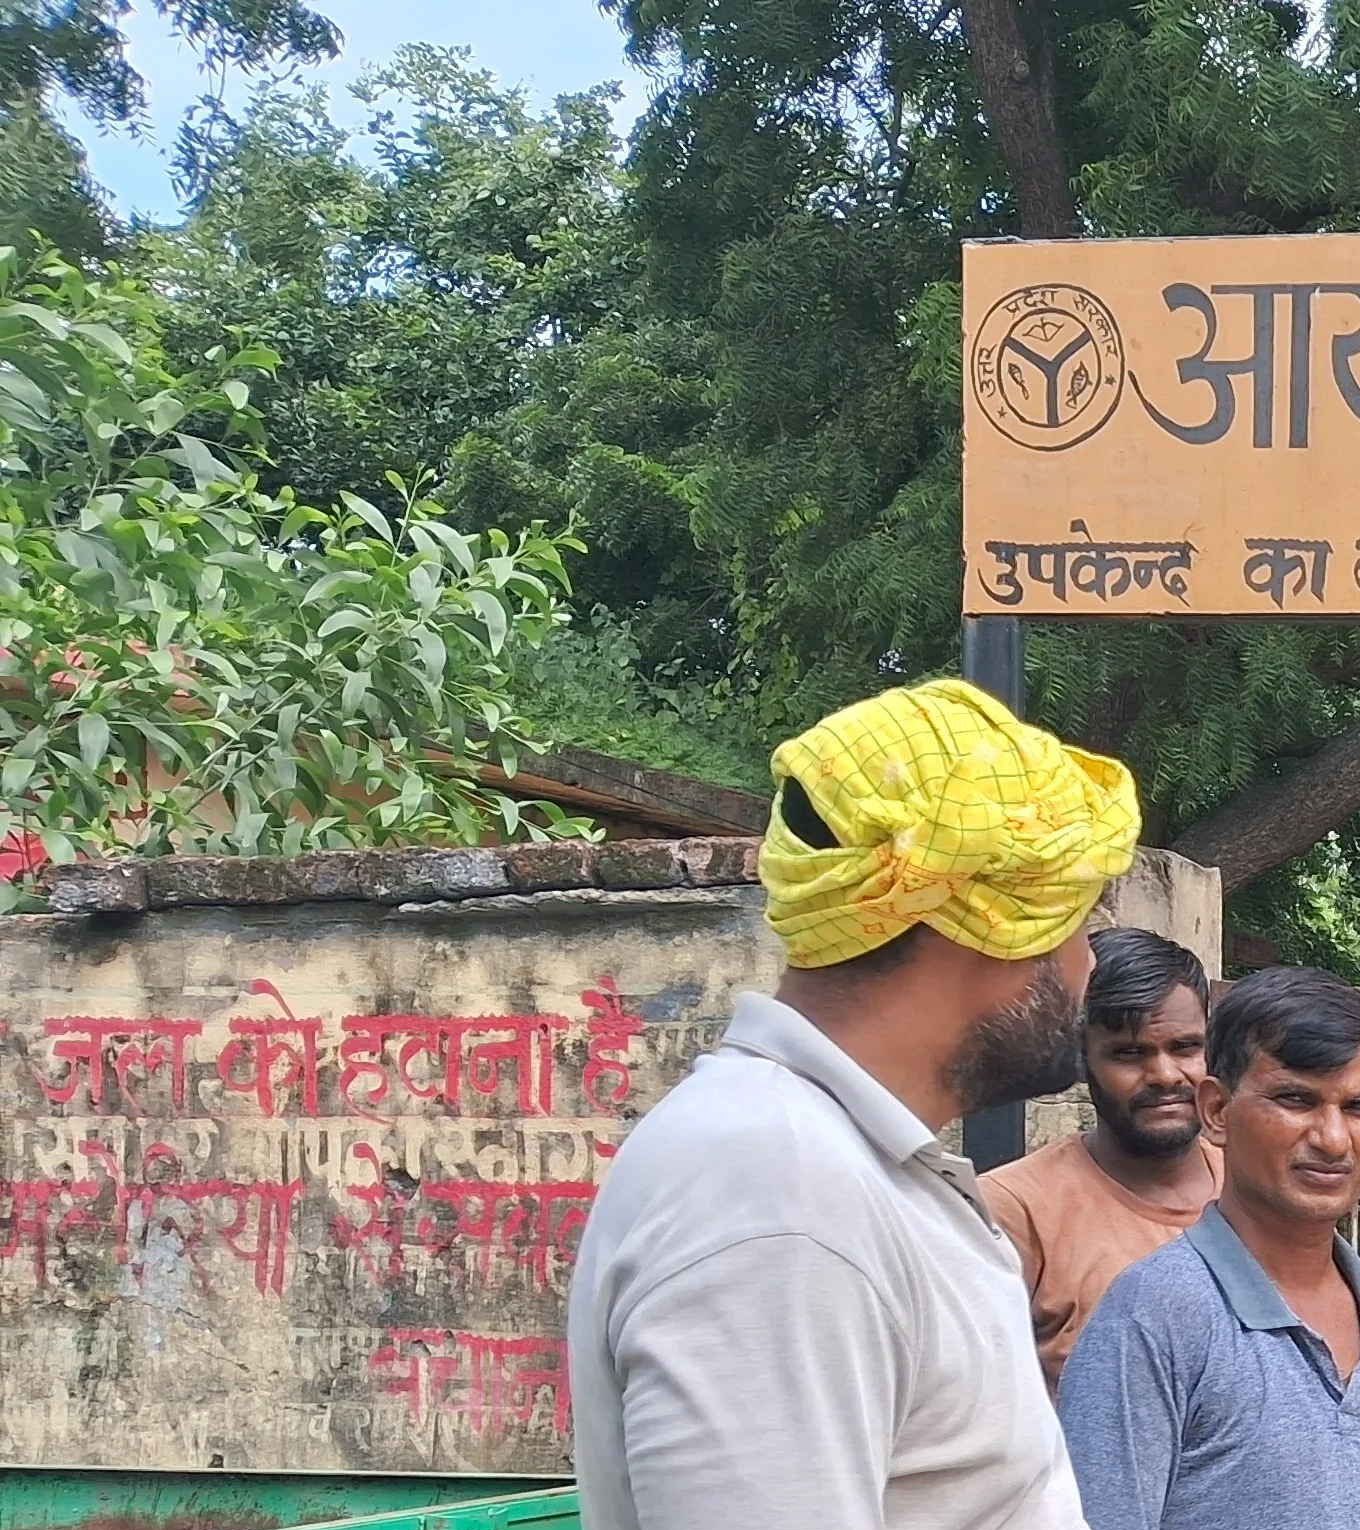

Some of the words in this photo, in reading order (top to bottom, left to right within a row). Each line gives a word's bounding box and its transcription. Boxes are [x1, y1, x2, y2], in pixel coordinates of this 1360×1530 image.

[1073, 293, 1119, 358] सरकार
[1244, 538, 1334, 610] का
[218, 978, 322, 1118] को
[339, 1013, 568, 1124] हटाना
[581, 974, 641, 1116] है
